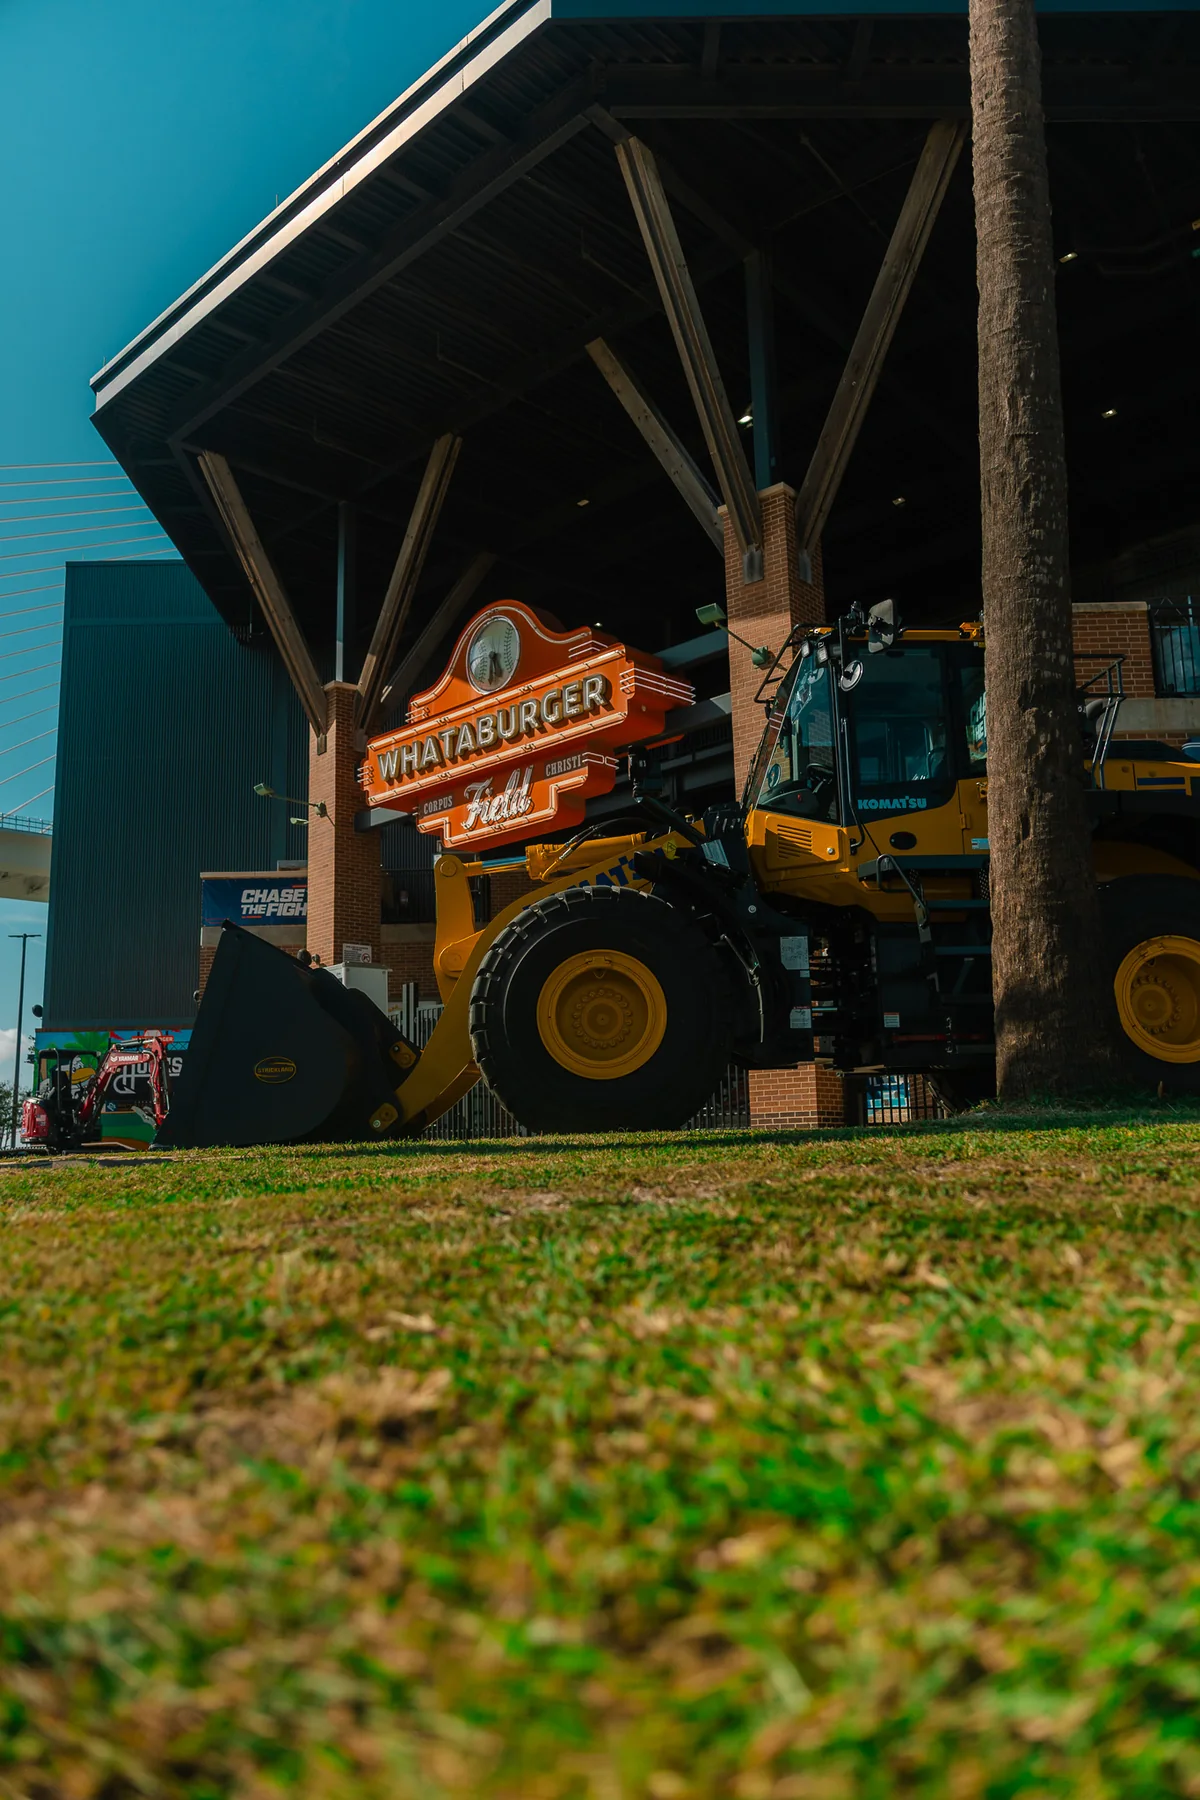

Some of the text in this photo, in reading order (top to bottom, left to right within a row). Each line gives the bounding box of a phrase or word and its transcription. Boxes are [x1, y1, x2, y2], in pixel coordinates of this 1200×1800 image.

[377, 673, 611, 782] WHATABURGER
[423, 753, 582, 814] CORPUS CHRISTI
[460, 765, 534, 830] Field
[857, 796, 927, 809] KOMATSU
[241, 888, 306, 903] CHASE
[241, 902, 307, 916] THE FIGH
